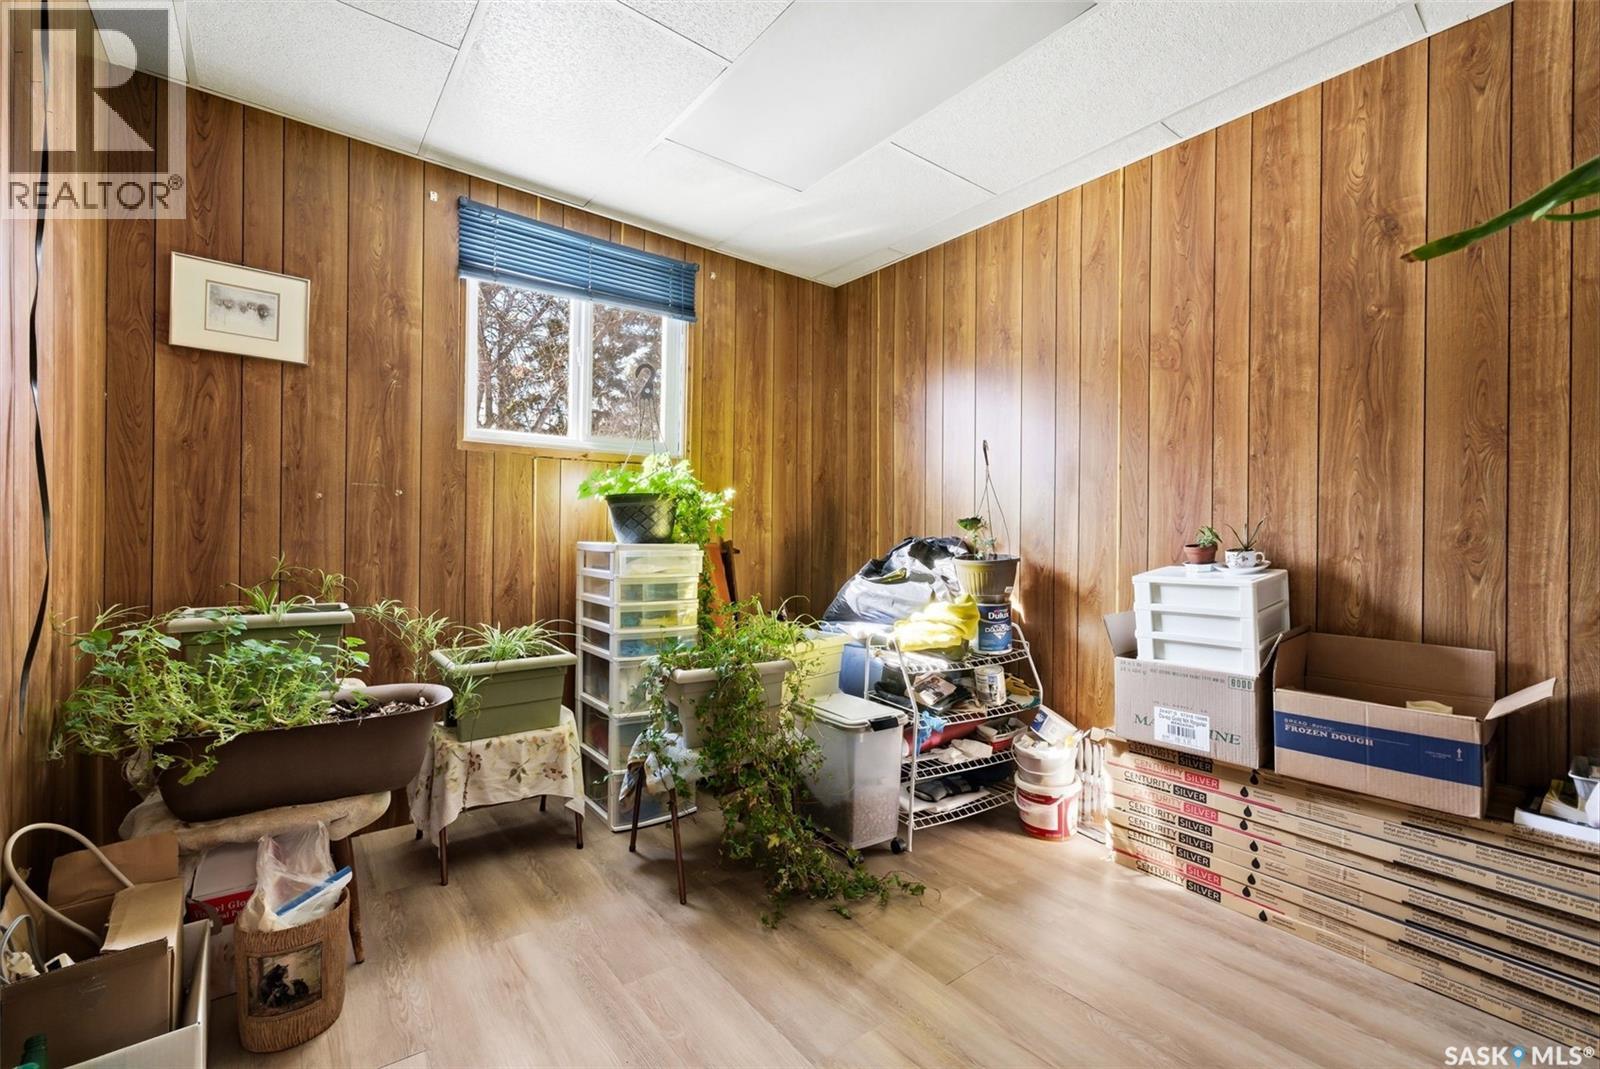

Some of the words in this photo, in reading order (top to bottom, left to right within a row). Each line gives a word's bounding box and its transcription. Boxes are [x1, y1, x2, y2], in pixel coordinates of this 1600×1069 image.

[1284, 724, 1328, 738] FROZEN
[1331, 733, 1374, 747] DOUGH
[1135, 759, 1183, 775] CENTURITY
[1186, 773, 1218, 788] SILVER
[1180, 757, 1211, 770] SILVER
[1124, 770, 1173, 790] CENTURITY
[1175, 786, 1206, 802] SILVER
[1129, 800, 1177, 820] CENTURITY
[1179, 818, 1211, 835] SILVER
[1185, 804, 1217, 820] SILVER
[1128, 816, 1177, 837] CENTURITY
[1180, 834, 1212, 851] SILVER
[1128, 830, 1175, 851] CENTURITY
[1177, 848, 1209, 866] SILVER
[1136, 860, 1185, 883] CENTURITY
[1188, 881, 1219, 901] SILVER
[1188, 866, 1220, 884] SILVER
